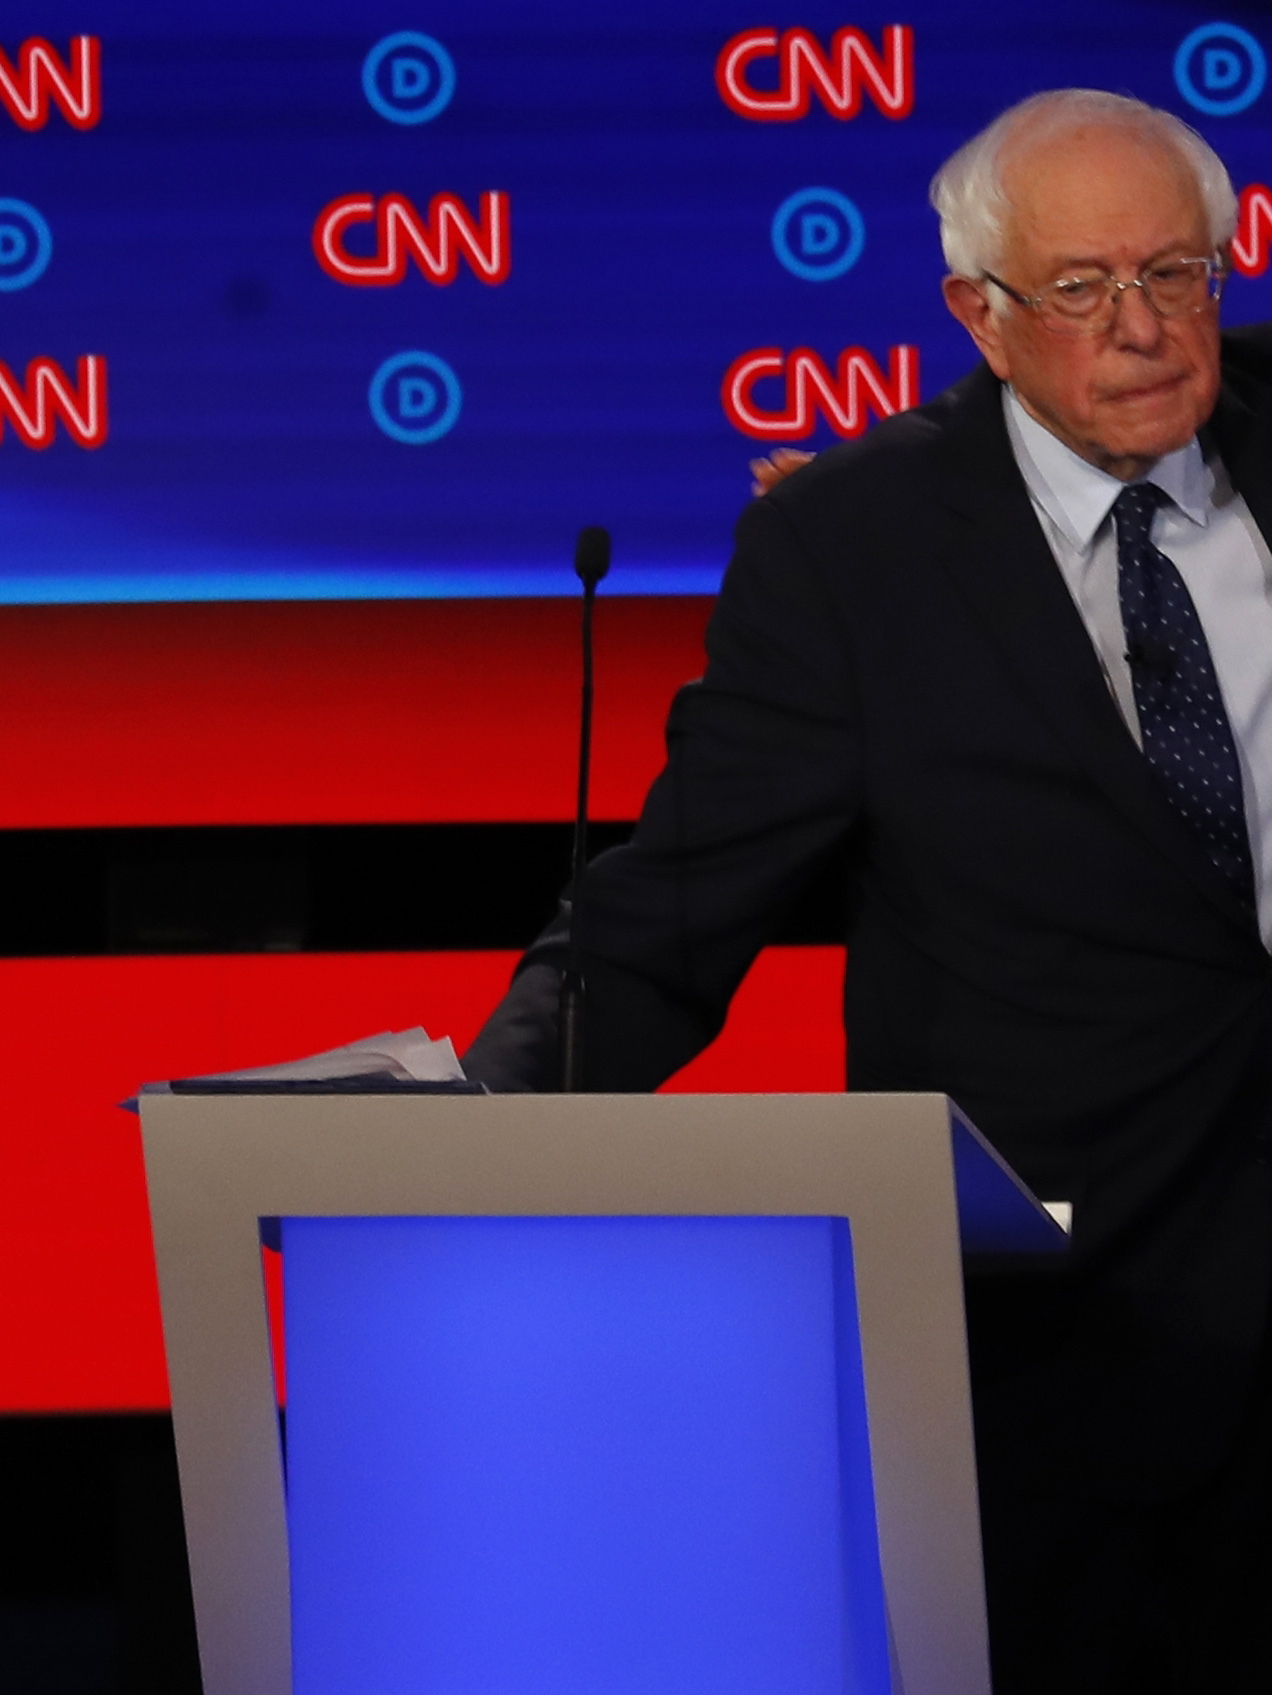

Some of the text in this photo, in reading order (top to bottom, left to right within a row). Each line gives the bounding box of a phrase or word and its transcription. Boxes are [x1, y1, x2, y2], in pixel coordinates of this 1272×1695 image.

[0, 36, 101, 131] NN
[394, 60, 429, 97] D
[716, 24, 914, 121] CNN
[1205, 51, 1240, 88] D
[312, 191, 511, 286] CNN
[803, 216, 838, 253] D
[0, 354, 108, 451] NN
[400, 379, 436, 417] D
[721, 345, 920, 441] CNN
